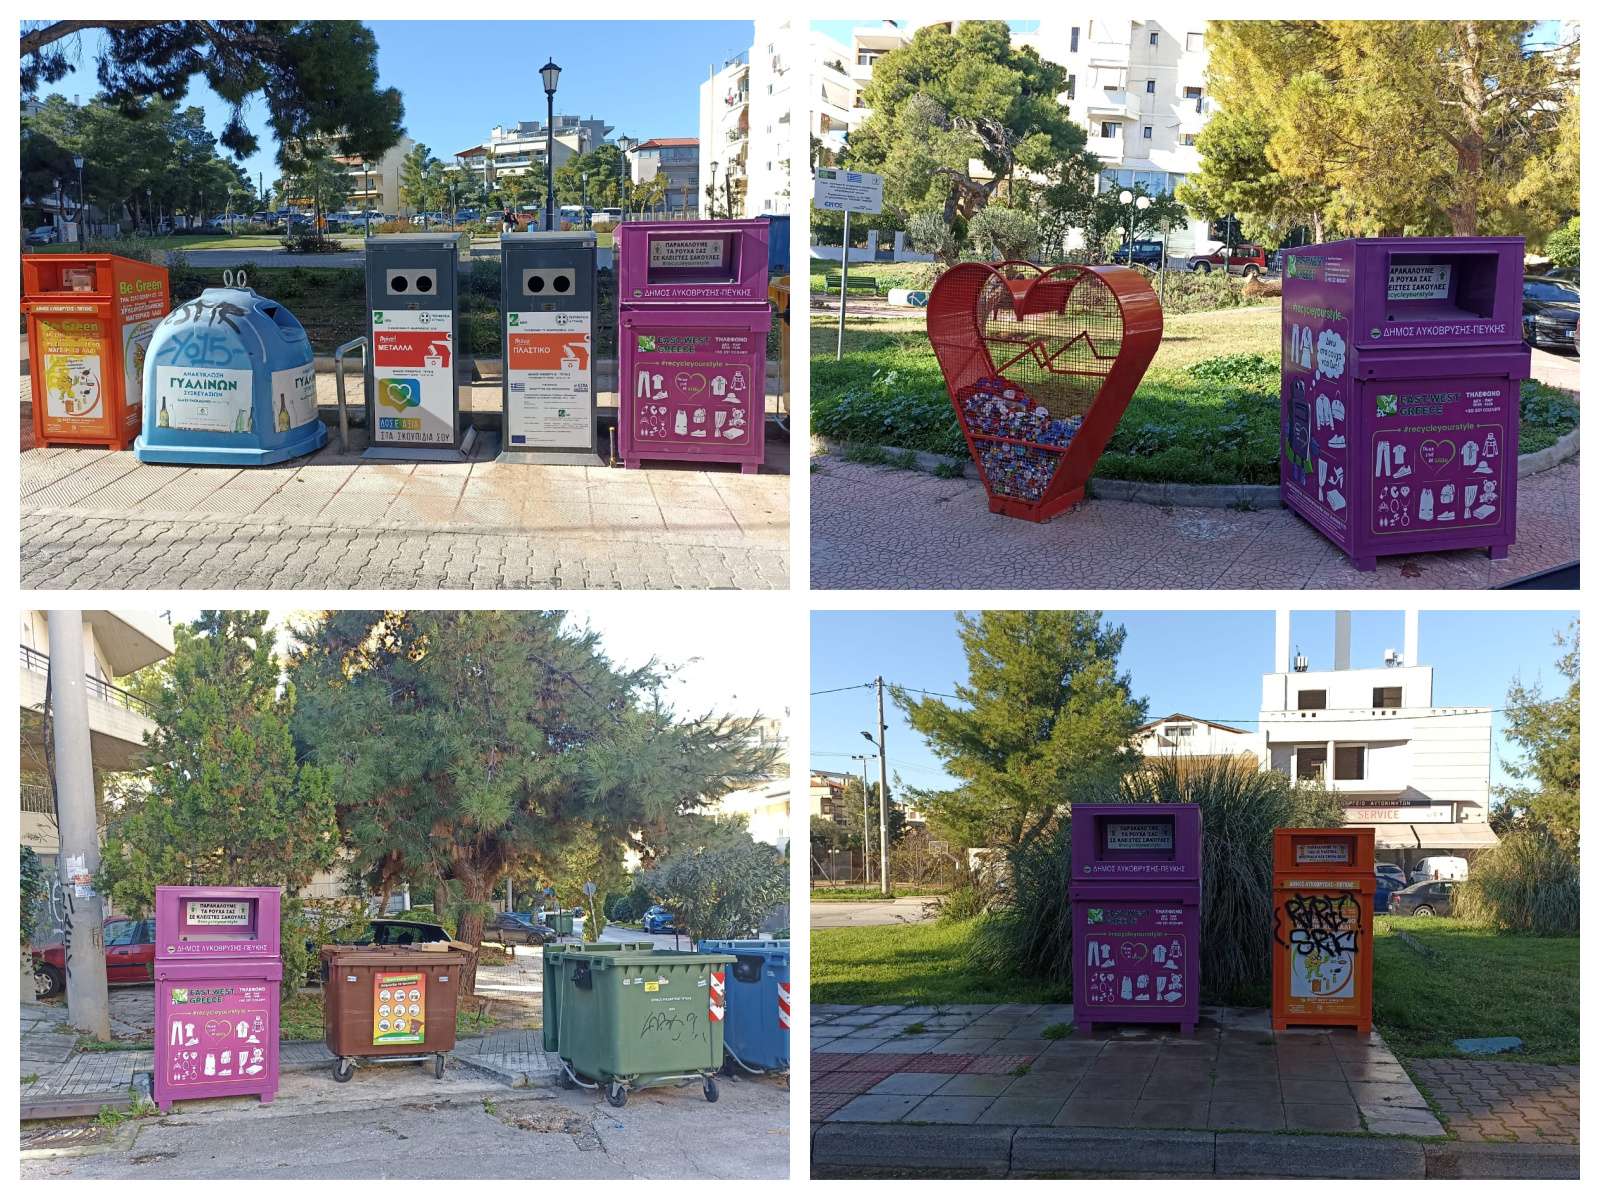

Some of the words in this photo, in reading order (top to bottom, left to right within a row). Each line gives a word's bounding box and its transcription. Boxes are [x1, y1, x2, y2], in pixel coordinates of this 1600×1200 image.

[1396, 275, 1418, 283] ΡΟΥΧΑ
[120, 281, 133, 294] Be
[135, 279, 162, 292] Green
[672, 289, 752, 297] ΛΥΚΟΒΡΥΣΗΣ-ΠΕΥΚΗΣ
[1383, 327, 1413, 337] ΔΗΜΟΣ
[1416, 324, 1505, 336] ΛΥΚΟΒΡΥΣΗΣ-ΠΕΥΚΗΣ
[513, 346, 551, 354] ΠΛΑΣΤΙΚΟ
[1466, 390, 1501, 398] ΤΗΛΕΦΩΝΟ
[1403, 422, 1474, 433] #recycleyourstyle
[1358, 810, 1399, 820] SERVICE
